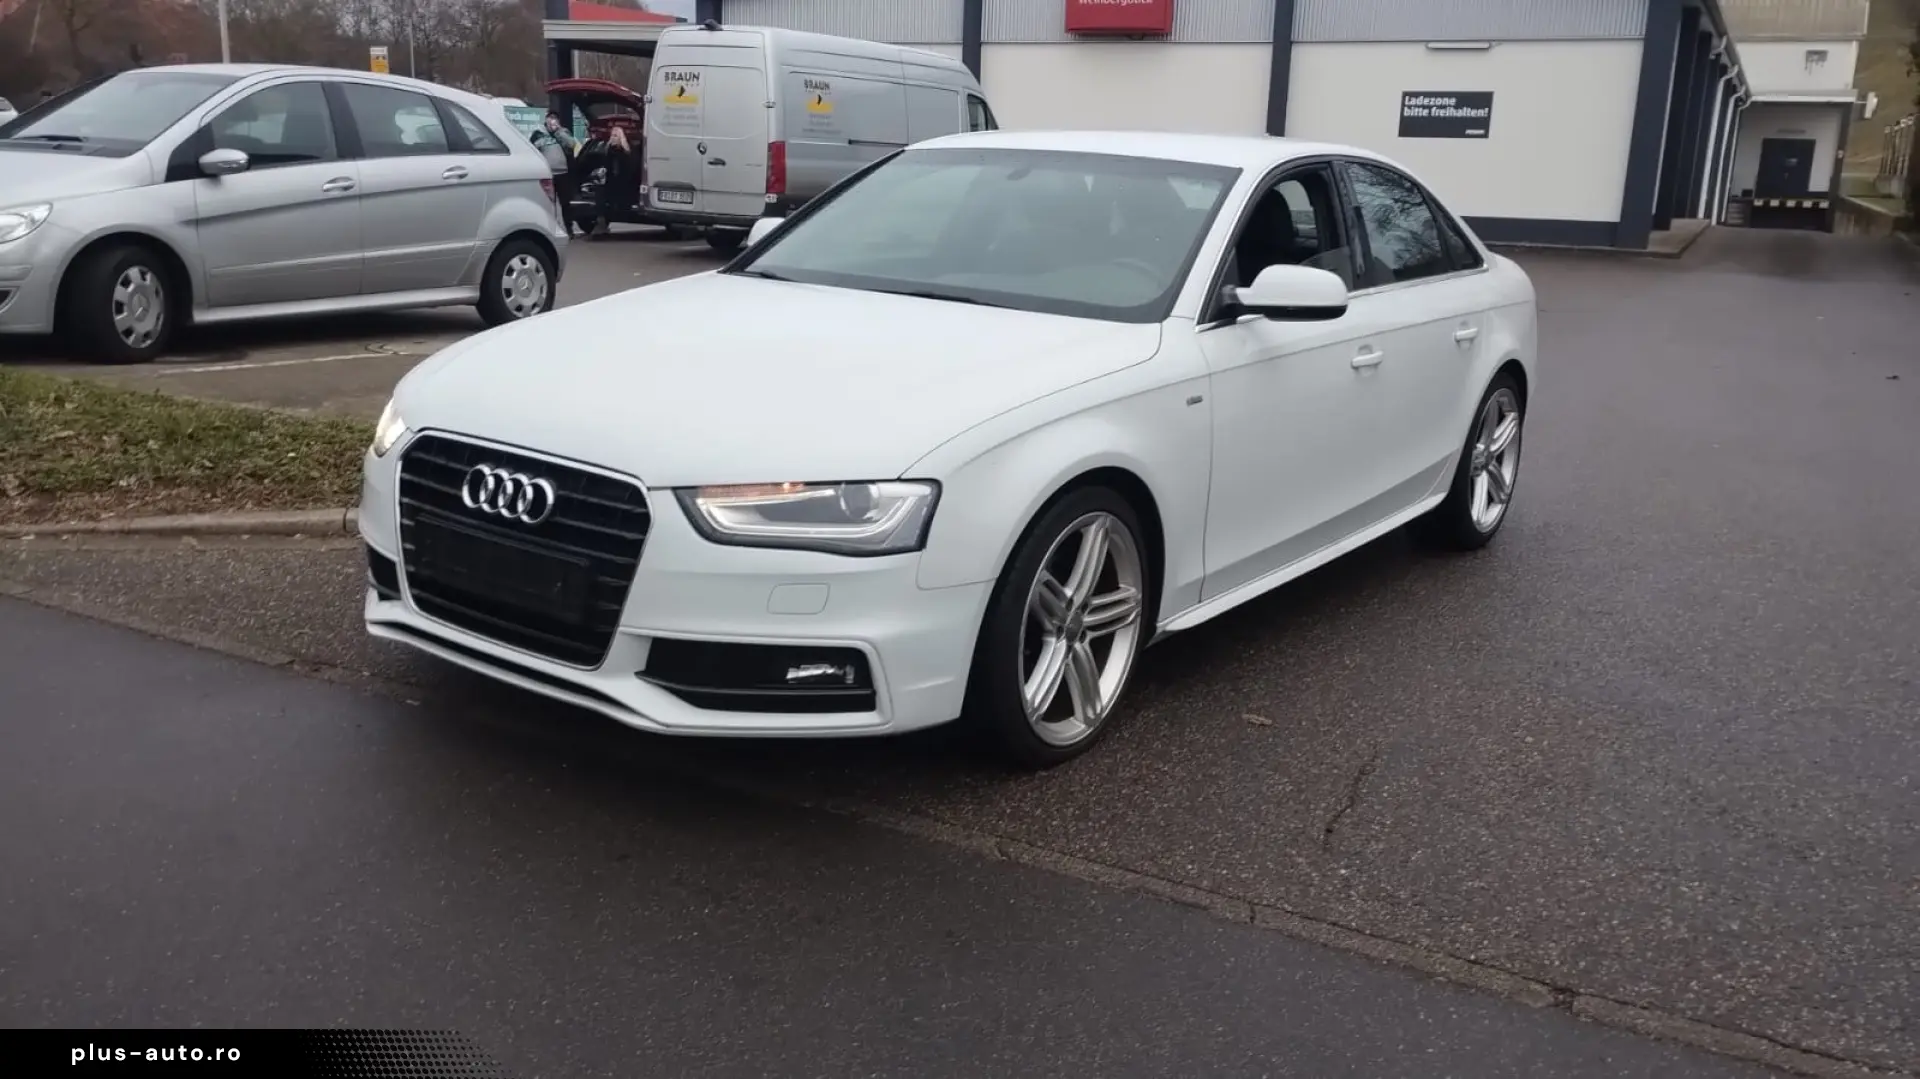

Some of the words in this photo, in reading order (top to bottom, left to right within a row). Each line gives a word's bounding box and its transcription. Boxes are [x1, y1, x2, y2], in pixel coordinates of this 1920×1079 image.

[664, 72, 700, 82] BRAUN
[804, 79, 830, 91] BRAUN
[1405, 95, 1457, 106] Ladezone
[1403, 106, 1430, 117] bitte
[1431, 106, 1490, 118] freihalten!
